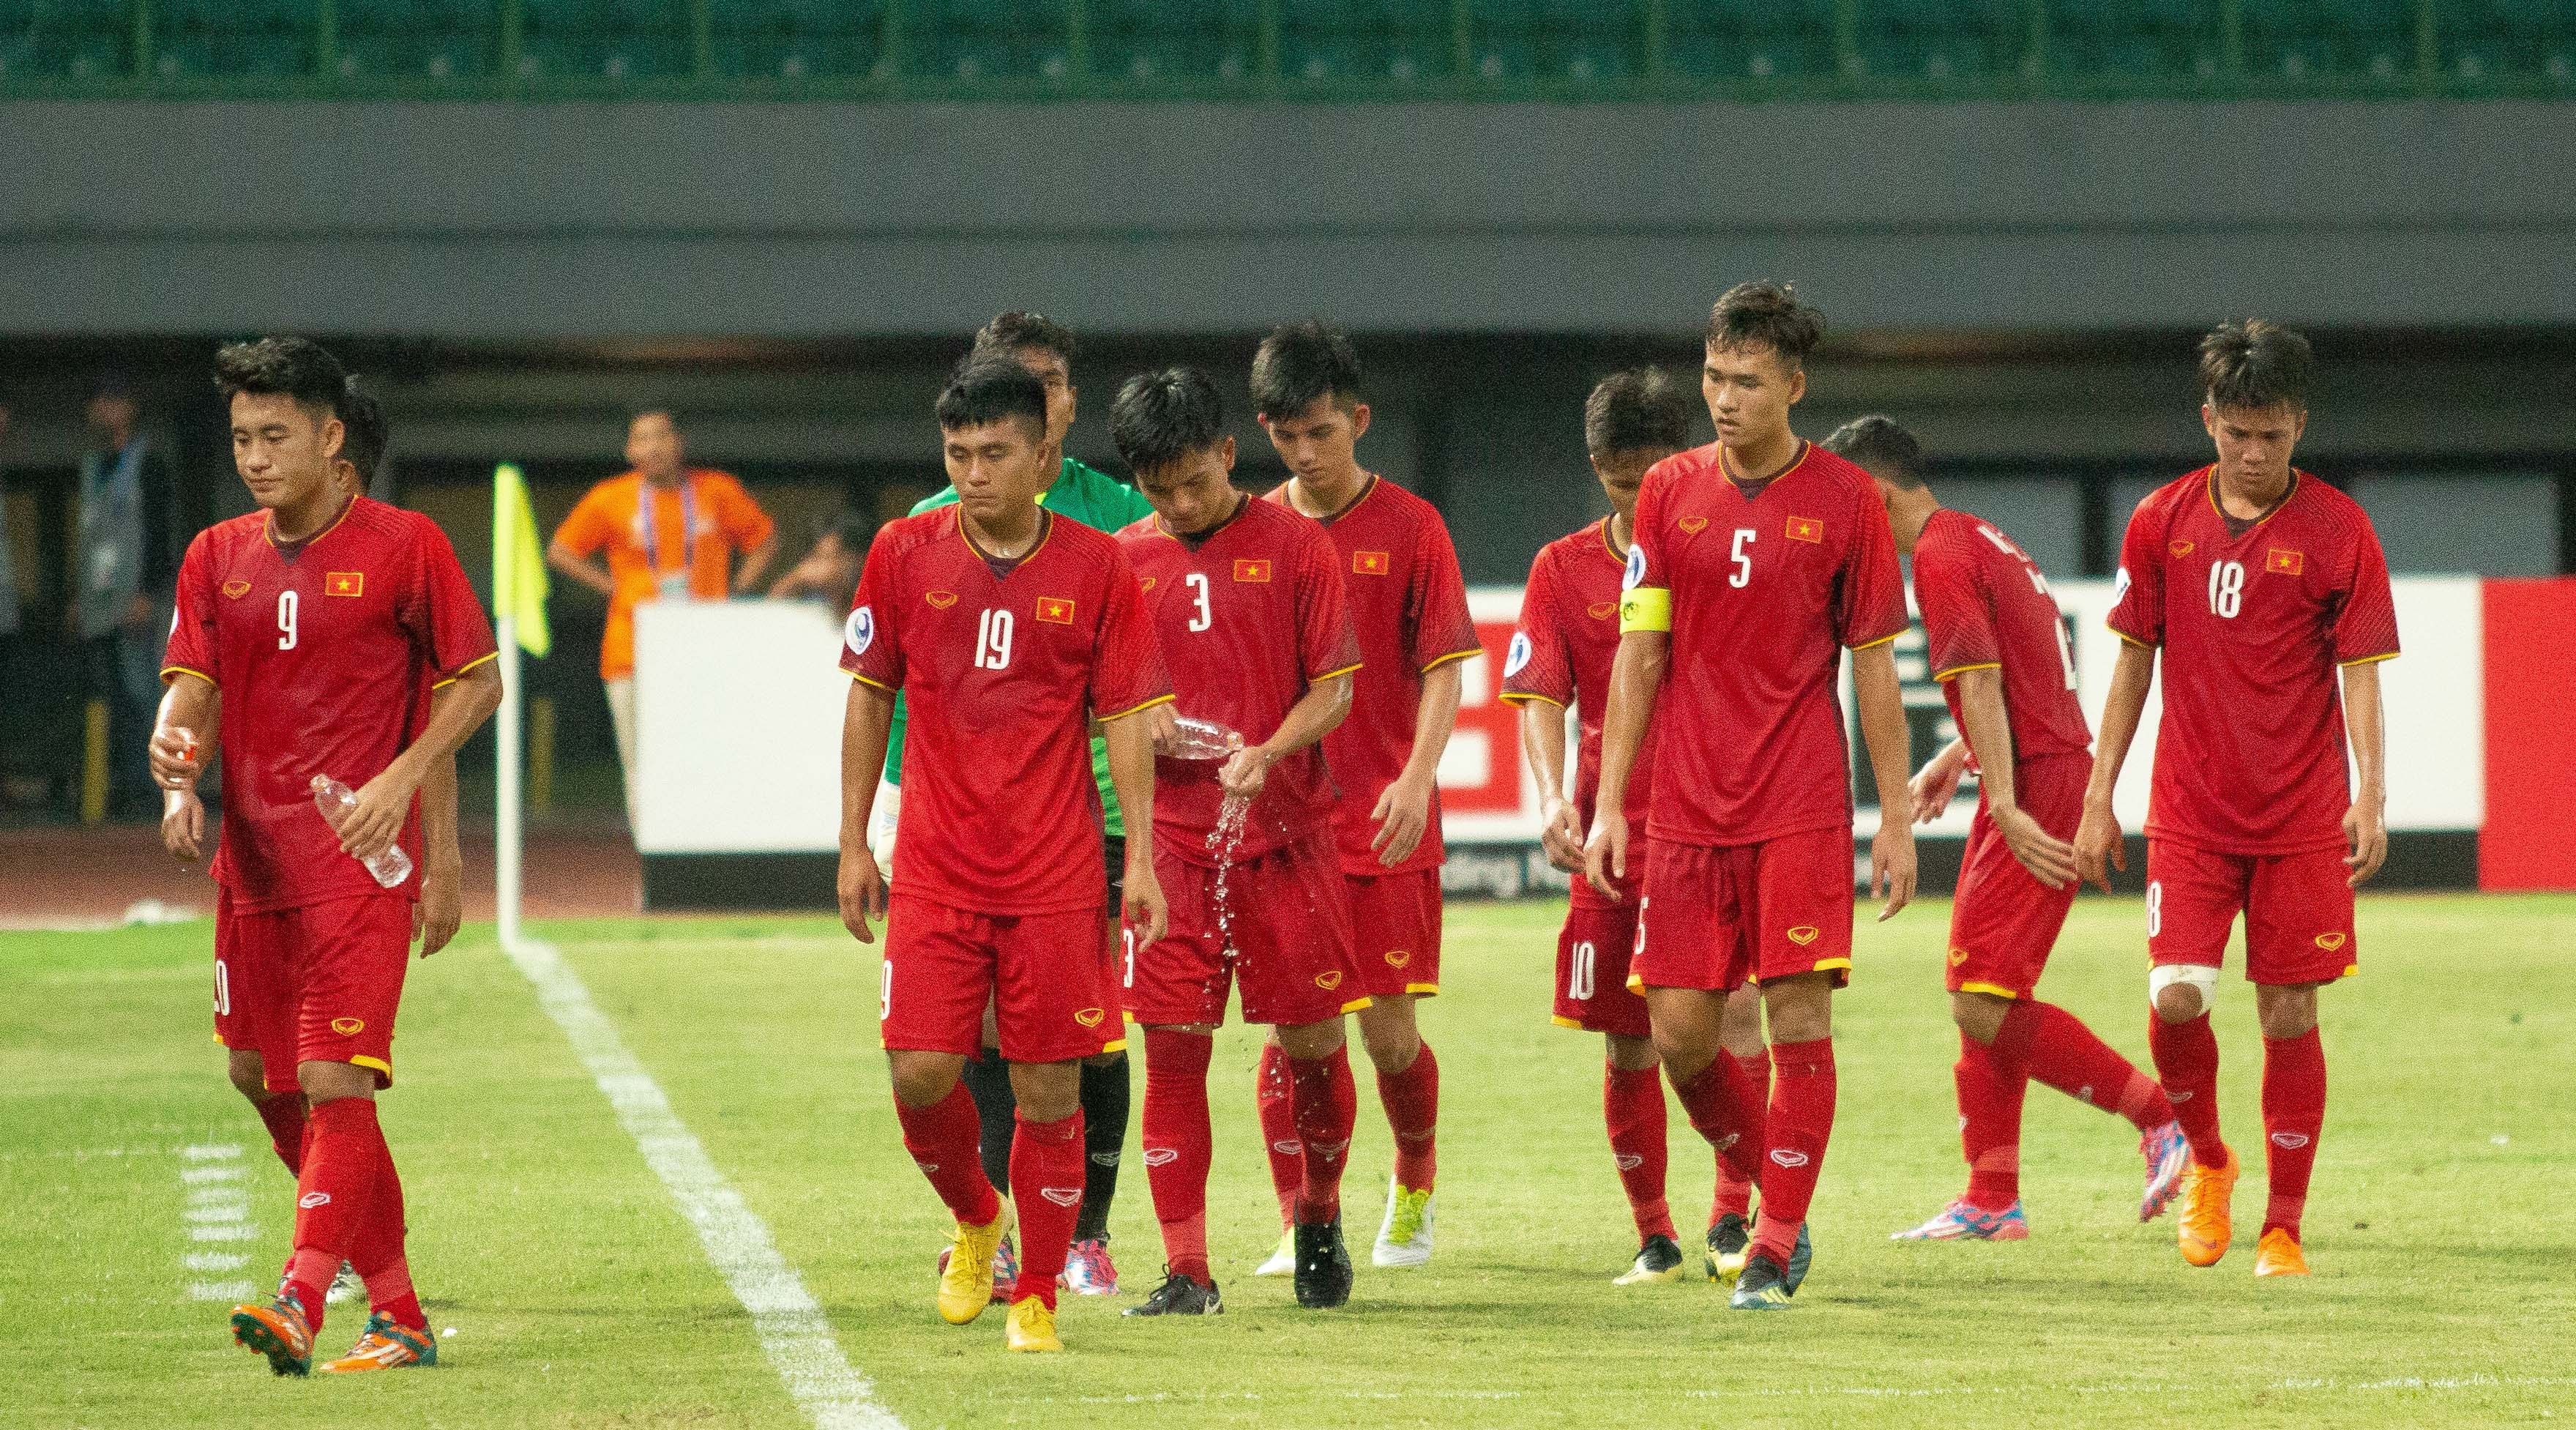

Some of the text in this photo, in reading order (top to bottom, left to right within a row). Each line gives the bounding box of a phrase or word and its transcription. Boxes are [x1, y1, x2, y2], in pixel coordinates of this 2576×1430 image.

[1729, 529, 1757, 588] 5
[1185, 573, 1212, 632] 3
[2209, 560, 2244, 619] 18
[278, 590, 299, 650] 9
[974, 608, 1014, 670] 19
[1635, 896, 1649, 955] 5
[214, 959, 230, 1016] 0
[1123, 928, 1134, 988] 3
[1569, 942, 1594, 1000] 10
